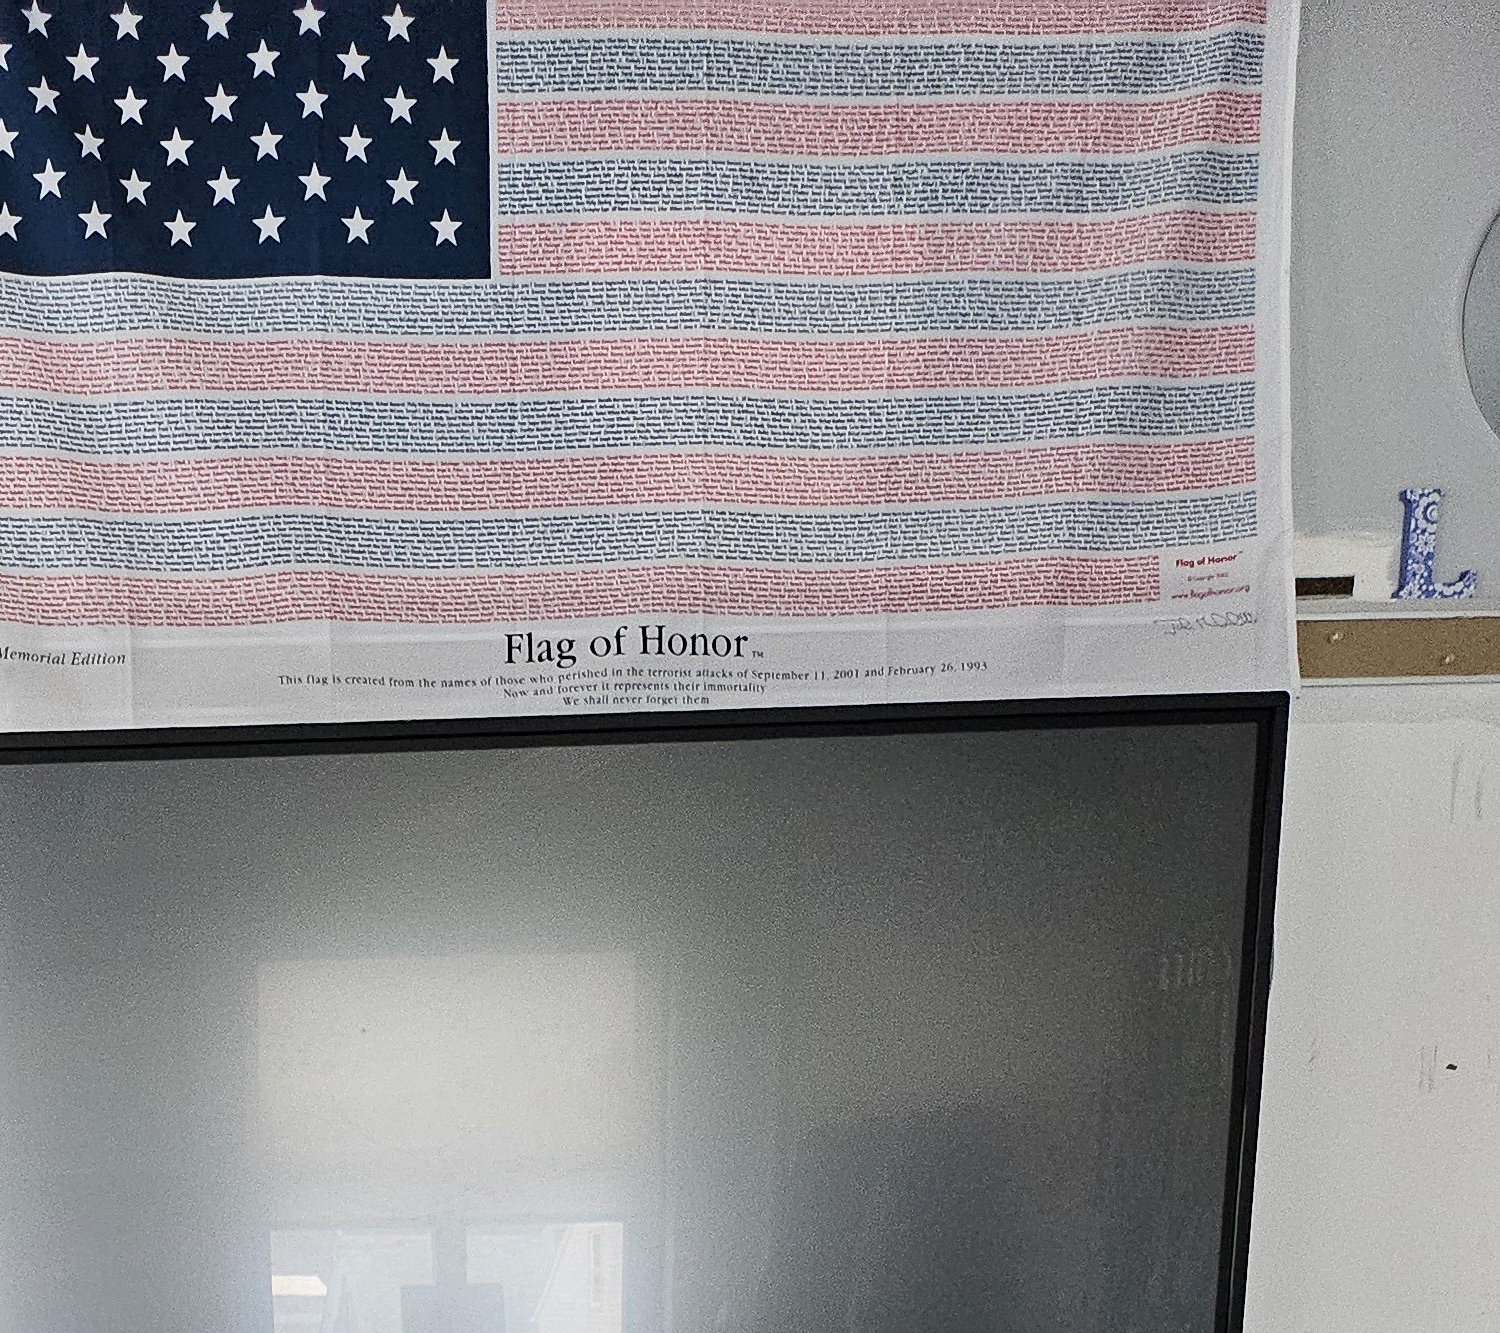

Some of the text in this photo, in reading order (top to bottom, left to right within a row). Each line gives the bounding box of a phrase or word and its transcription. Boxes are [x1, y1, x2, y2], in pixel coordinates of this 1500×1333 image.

[1175, 555, 1238, 568] Flag of Honor
[503, 632, 577, 669] Flag
[589, 625, 628, 657] of
[638, 625, 749, 658] Honor
[71, 651, 126, 666] Edition
[278, 675, 302, 686] This
[306, 674, 329, 686] flag
[332, 674, 342, 685] is
[344, 675, 385, 686] created
[389, 677, 415, 688] from
[418, 678, 437, 688] the
[440, 680, 477, 689] names
[480, 676, 493, 687] of
[495, 676, 526, 687] those
[529, 674, 554, 685] who
[558, 667, 609, 684] perished
[612, 668, 623, 678] in
[626, 666, 644, 677] the
[648, 668, 692, 679] terrorist
[695, 669, 734, 679] attacks
[736, 668, 750, 679] of
[751, 669, 809, 683] September
[833, 668, 860, 680] 2001
[864, 667, 885, 678] and
[888, 664, 936, 678] February
[960, 660, 989, 672] 1993
[503, 681, 767, 700] Now and forever it represents their immortality
[563, 693, 710, 707] We shall never forget them
